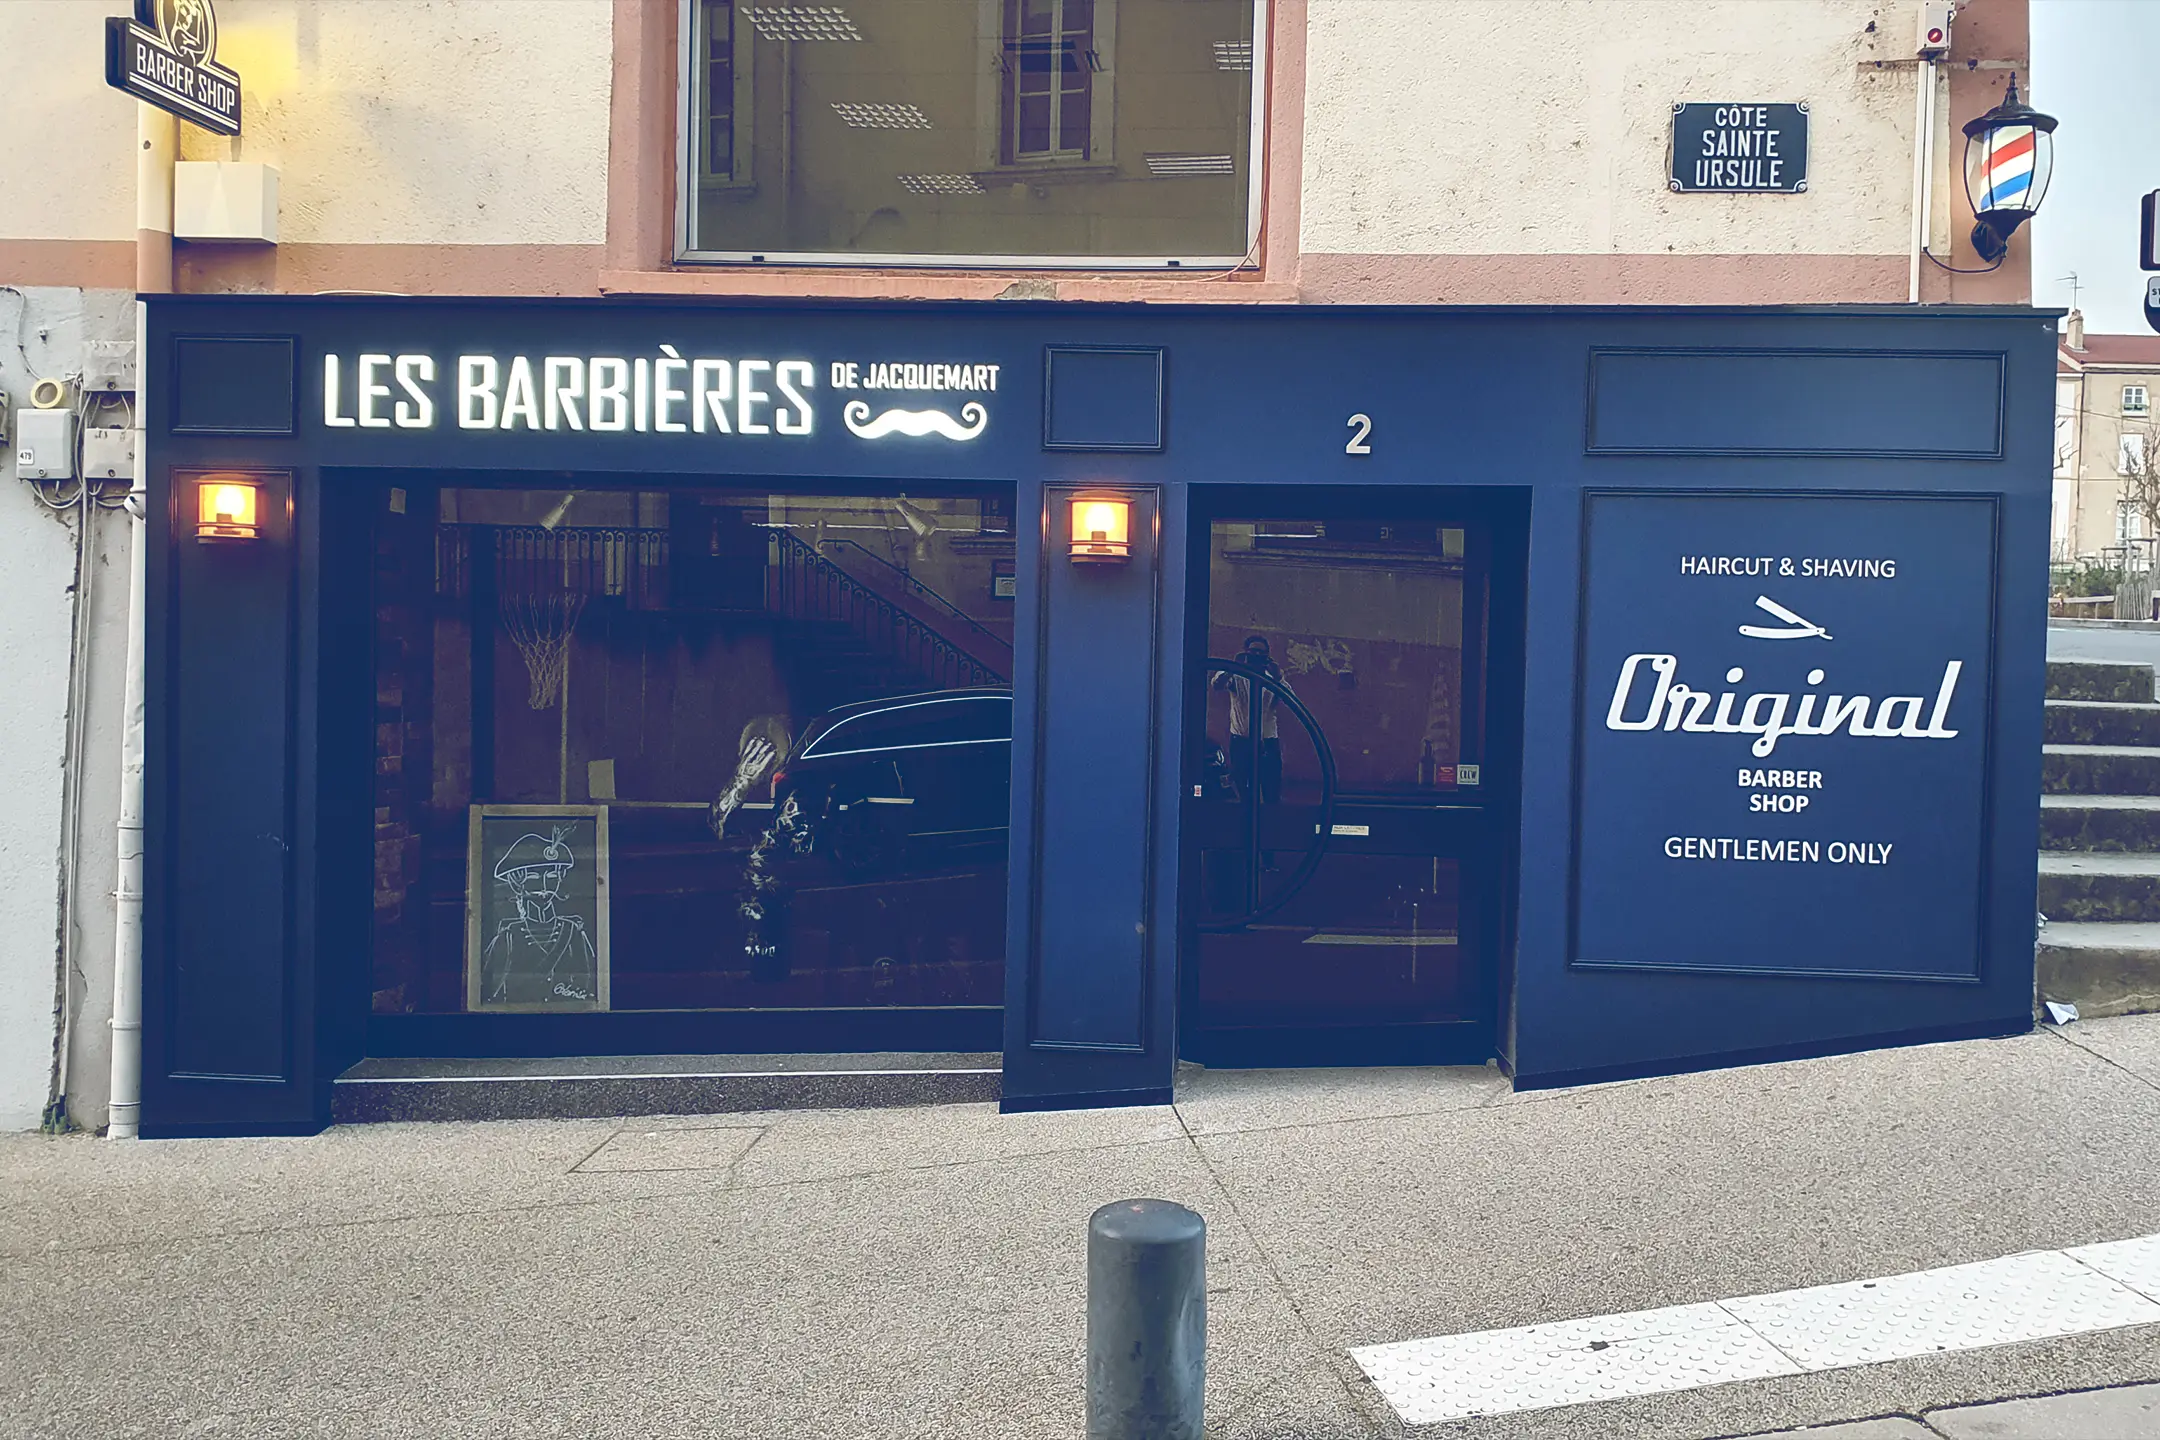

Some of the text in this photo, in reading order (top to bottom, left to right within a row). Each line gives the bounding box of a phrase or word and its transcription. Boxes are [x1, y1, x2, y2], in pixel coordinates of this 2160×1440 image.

[136, 42, 235, 115] BARBER SHOP
[1715, 104, 1768, 127] CÔTE
[1702, 129, 1780, 157] SAINTE
[1695, 159, 1784, 188] URSULE
[324, 345, 814, 435] LES BARBIÈRES
[831, 362, 1000, 391] DE JACQUEMART
[1345, 413, 1372, 454] 2
[1681, 556, 1896, 578] HAIRCUT & SHAVING
[1606, 653, 1963, 758] Original
[1738, 769, 1823, 789] BARBER
[1749, 793, 1809, 813] SHOP
[1664, 836, 1893, 865] GENTLEMEN ONLY
